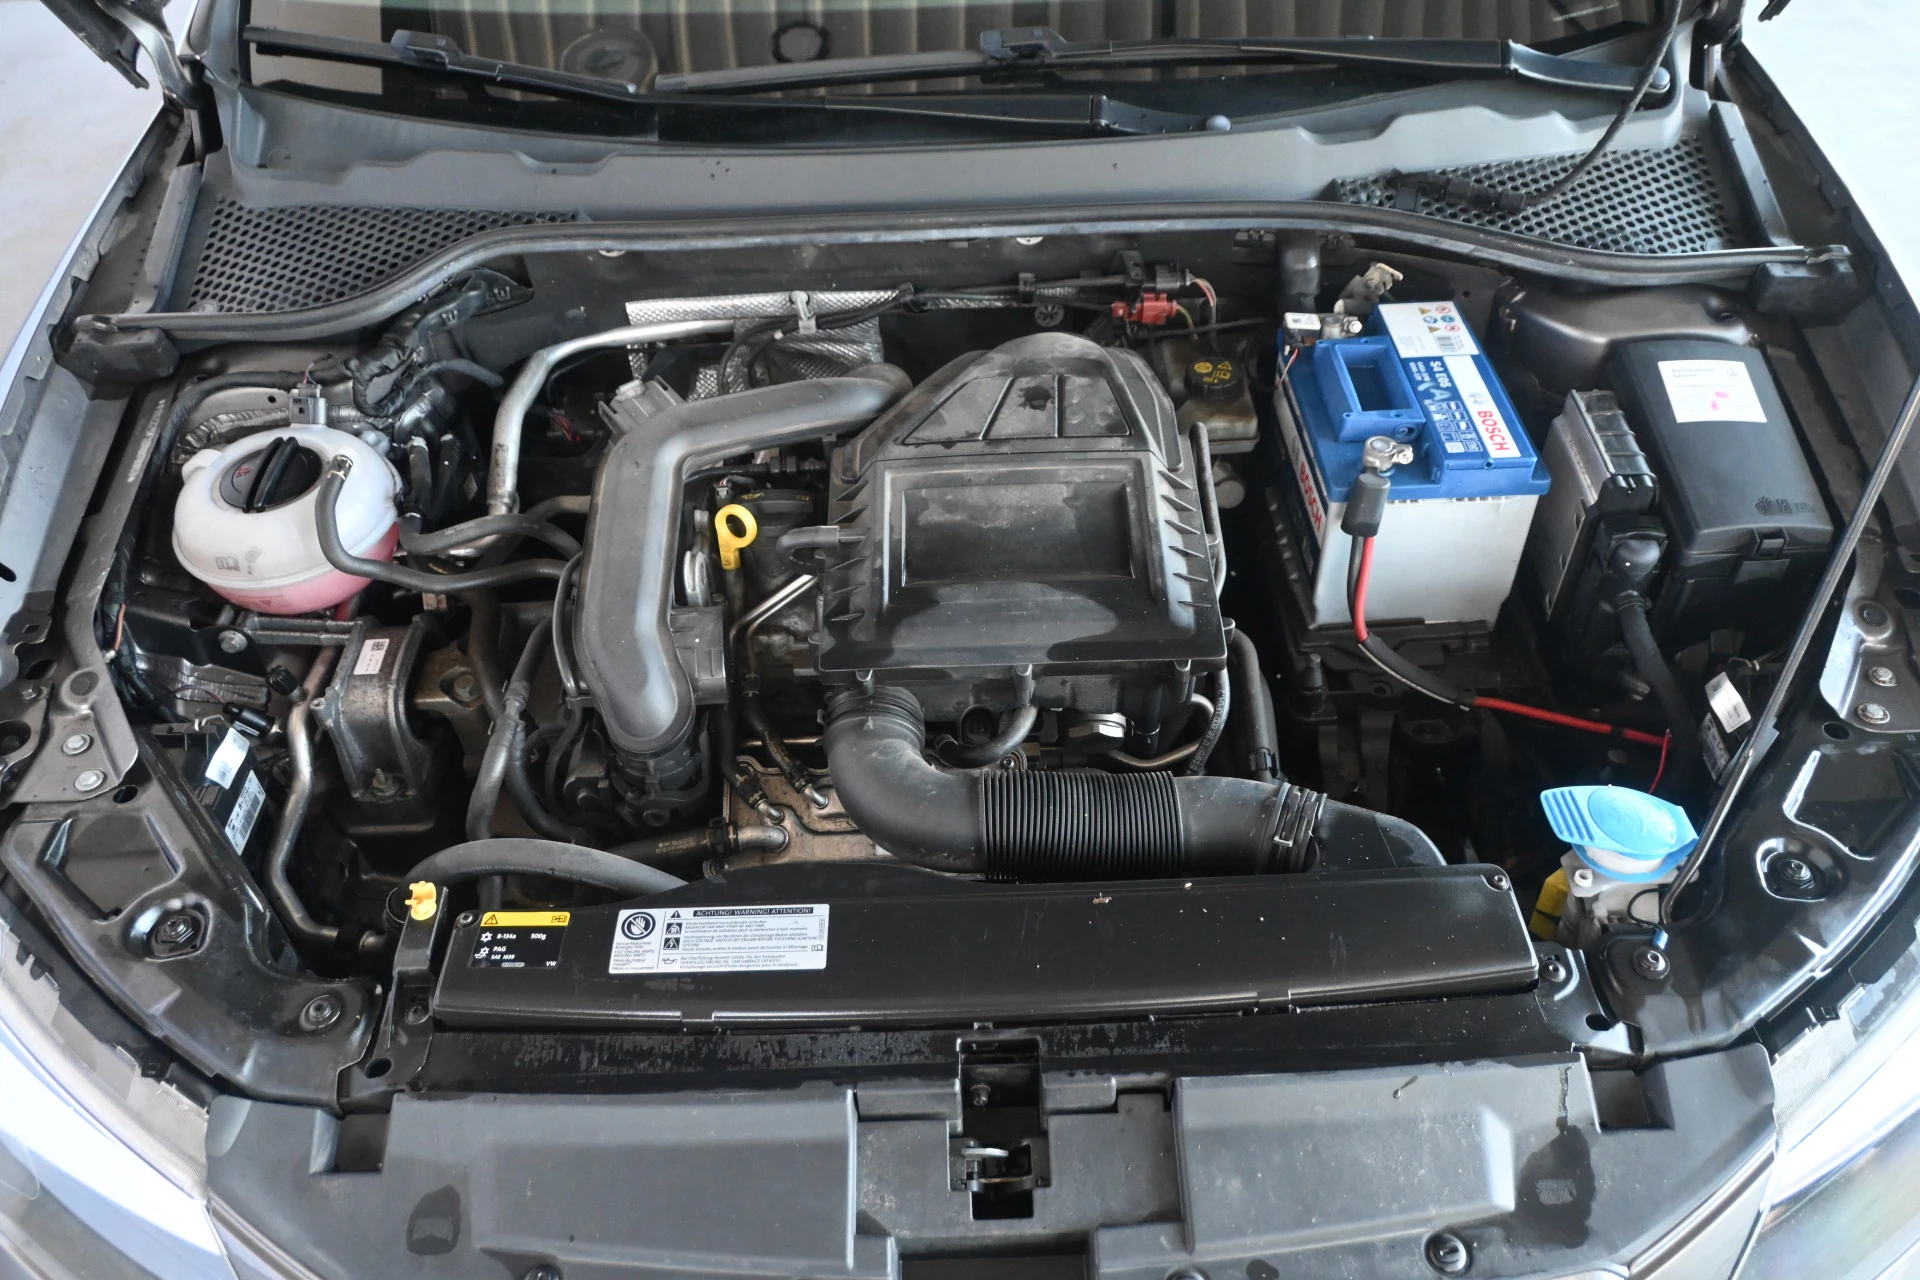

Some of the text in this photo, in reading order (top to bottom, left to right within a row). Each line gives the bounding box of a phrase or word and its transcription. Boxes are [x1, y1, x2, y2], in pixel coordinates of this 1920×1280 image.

[1430, 361, 1444, 372] S4
[1477, 410, 1511, 451] BOSCH
[1299, 461, 1322, 533] BOSCH
